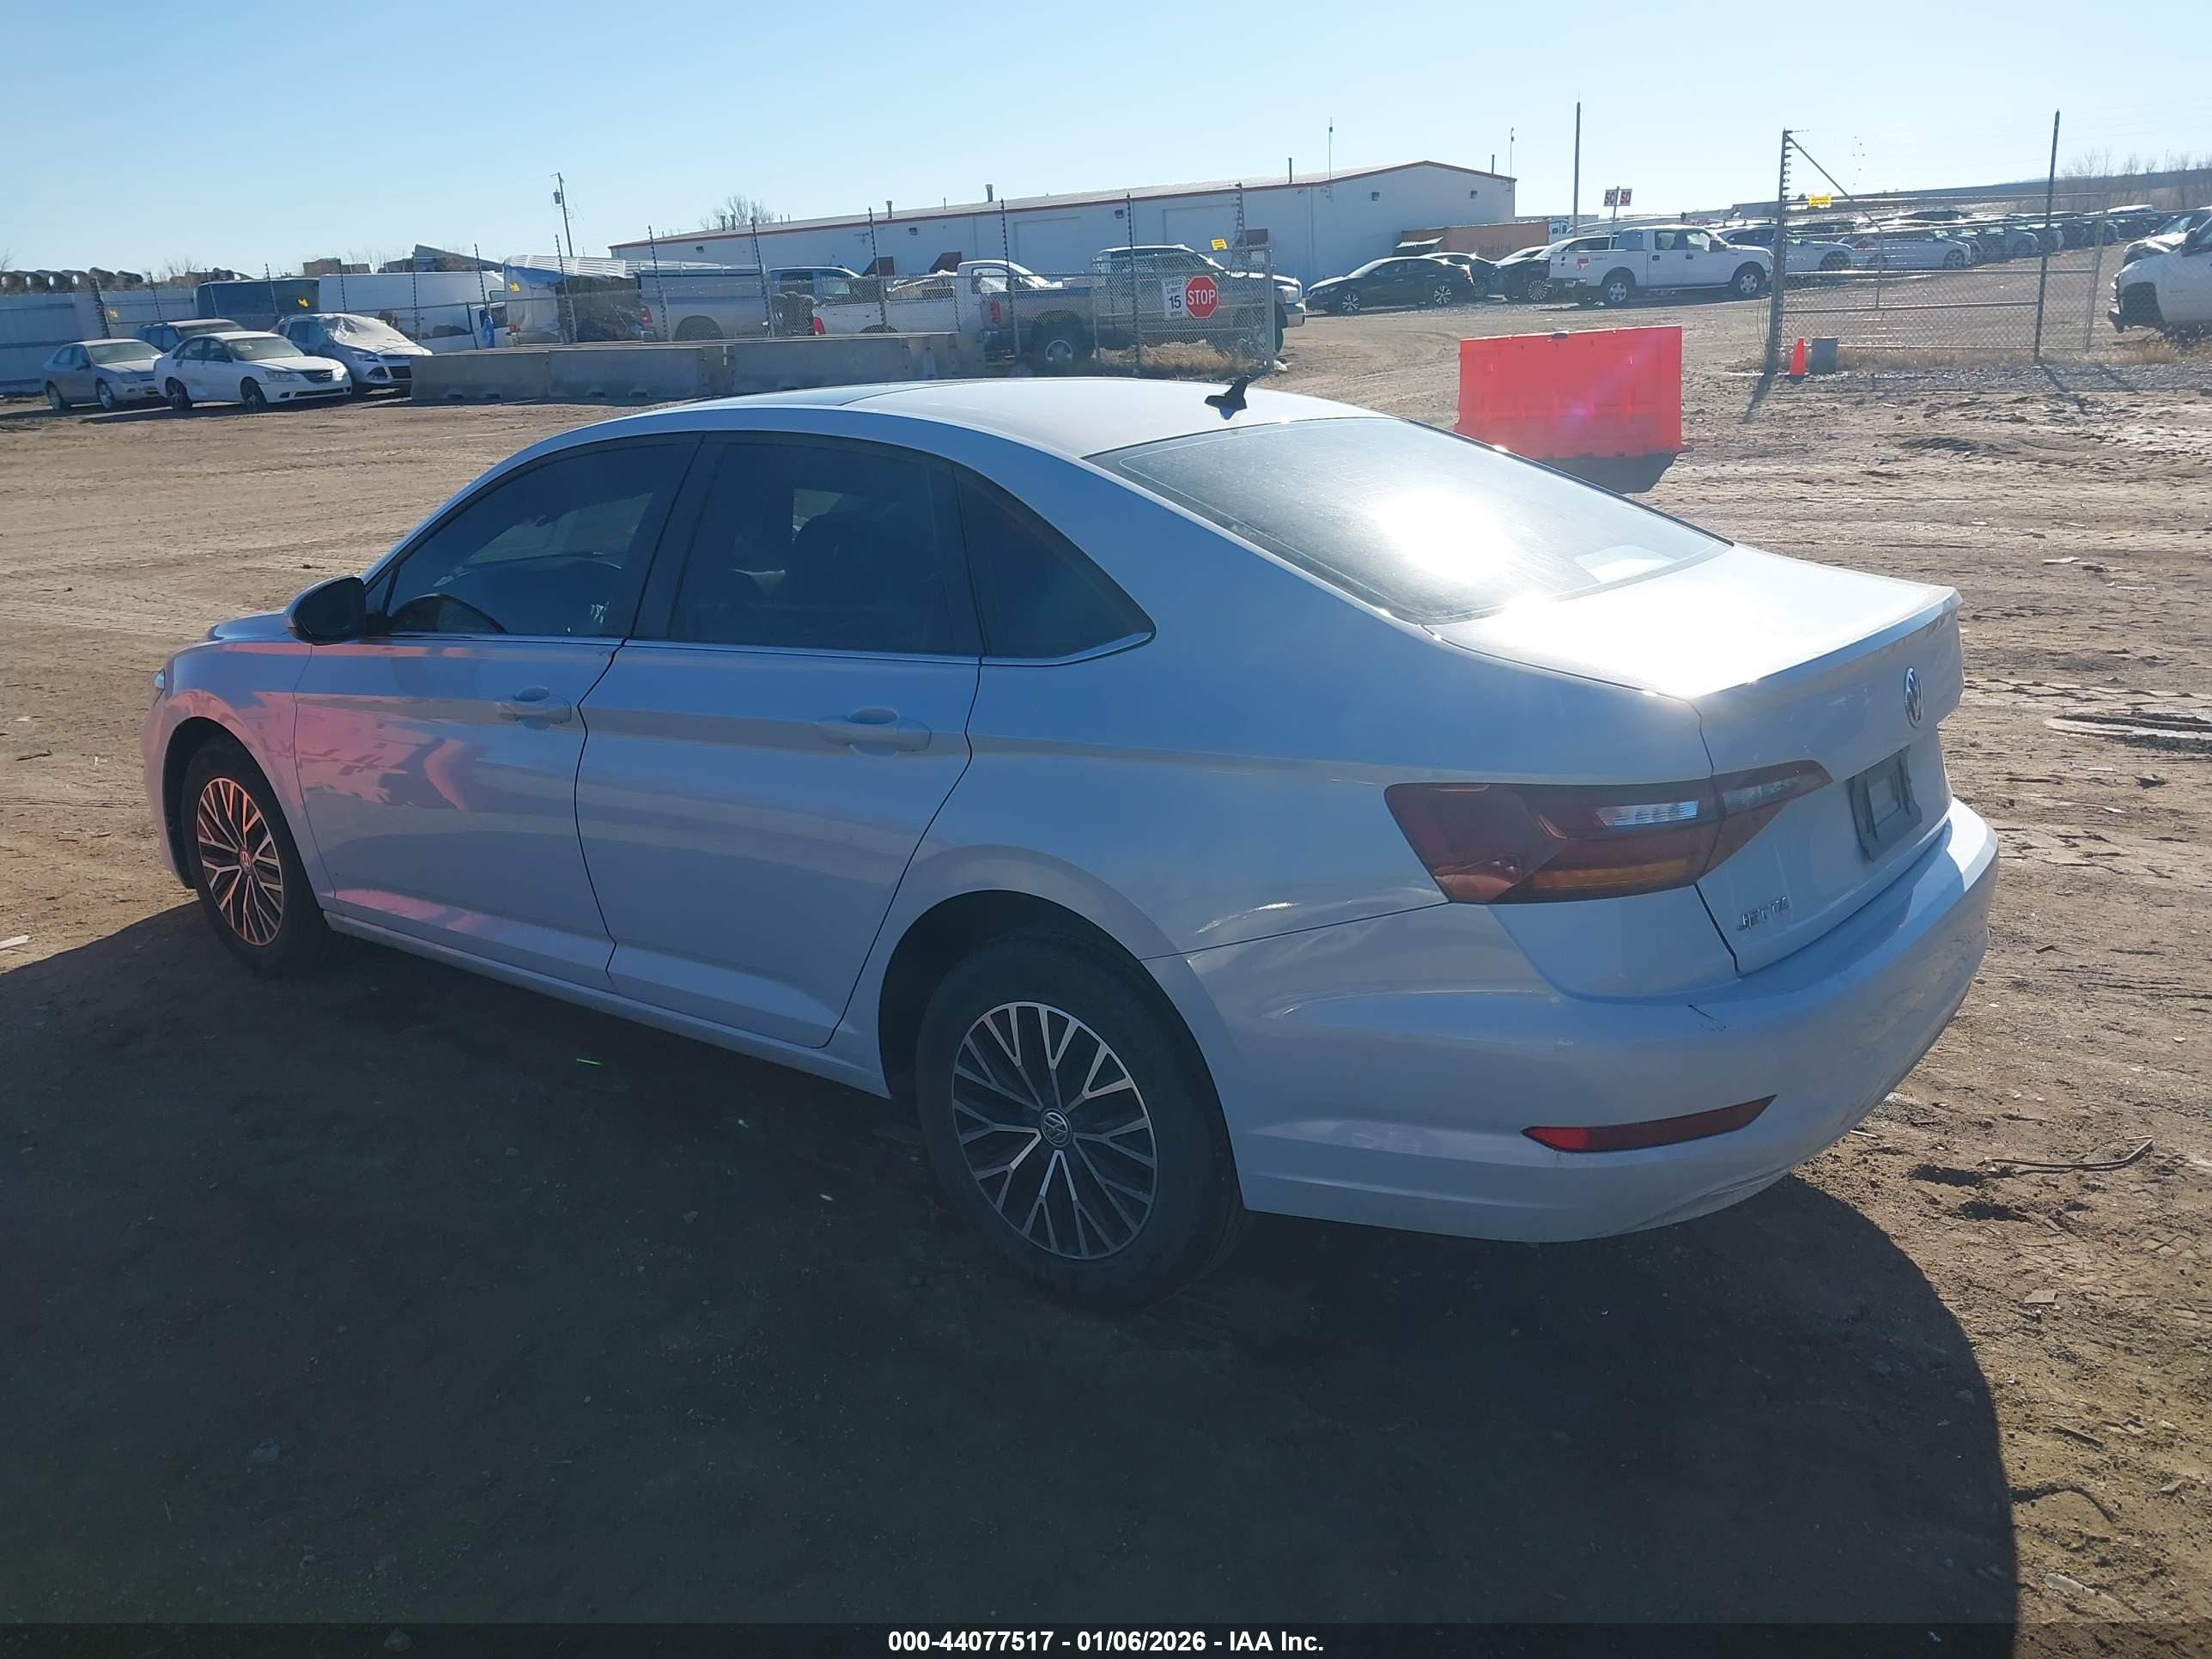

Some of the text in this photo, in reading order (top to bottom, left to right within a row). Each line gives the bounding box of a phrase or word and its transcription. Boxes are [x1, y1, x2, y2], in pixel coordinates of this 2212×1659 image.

[1169, 295, 1182, 309] 15
[1188, 289, 1216, 305] STOP
[1736, 896, 1790, 932] JETTA
